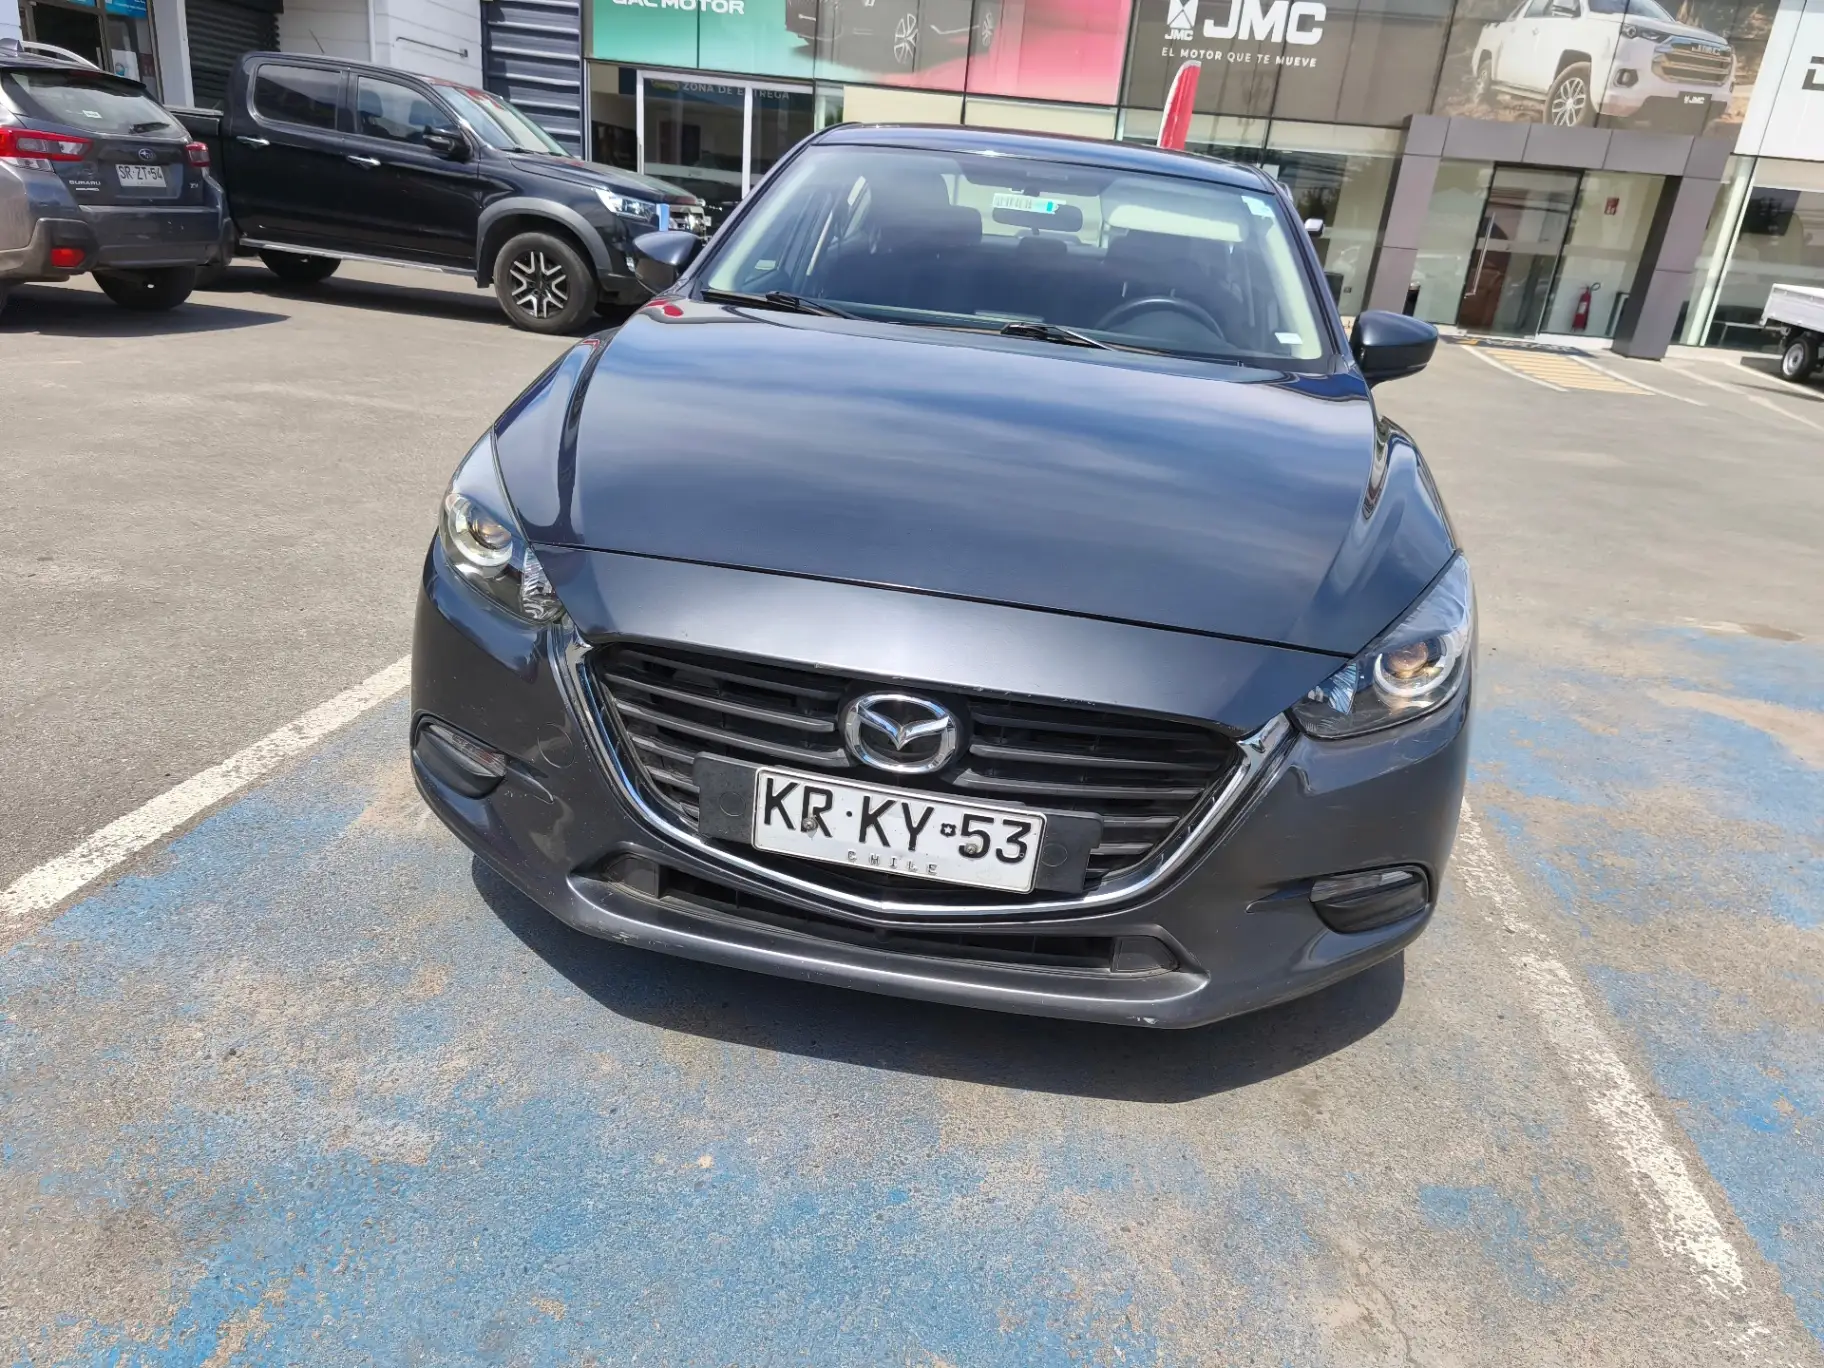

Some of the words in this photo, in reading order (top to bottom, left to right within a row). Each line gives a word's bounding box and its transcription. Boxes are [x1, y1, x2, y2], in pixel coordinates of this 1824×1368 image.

[661, 0, 745, 14] MOTOR
[1203, 0, 1327, 45] JMC
[1165, 29, 1194, 41] JMC
[1161, 47, 1175, 57] EL
[1180, 48, 1223, 61] MOTOR
[1227, 52, 1252, 63] QUE
[1257, 54, 1271, 64] TE
[1275, 56, 1317, 68] MUEVE
[682, 83, 714, 93] ZONA
[718, 86, 733, 95] DE
[737, 87, 790, 100] ETREGA
[847, 850, 938, 875] CHILE
